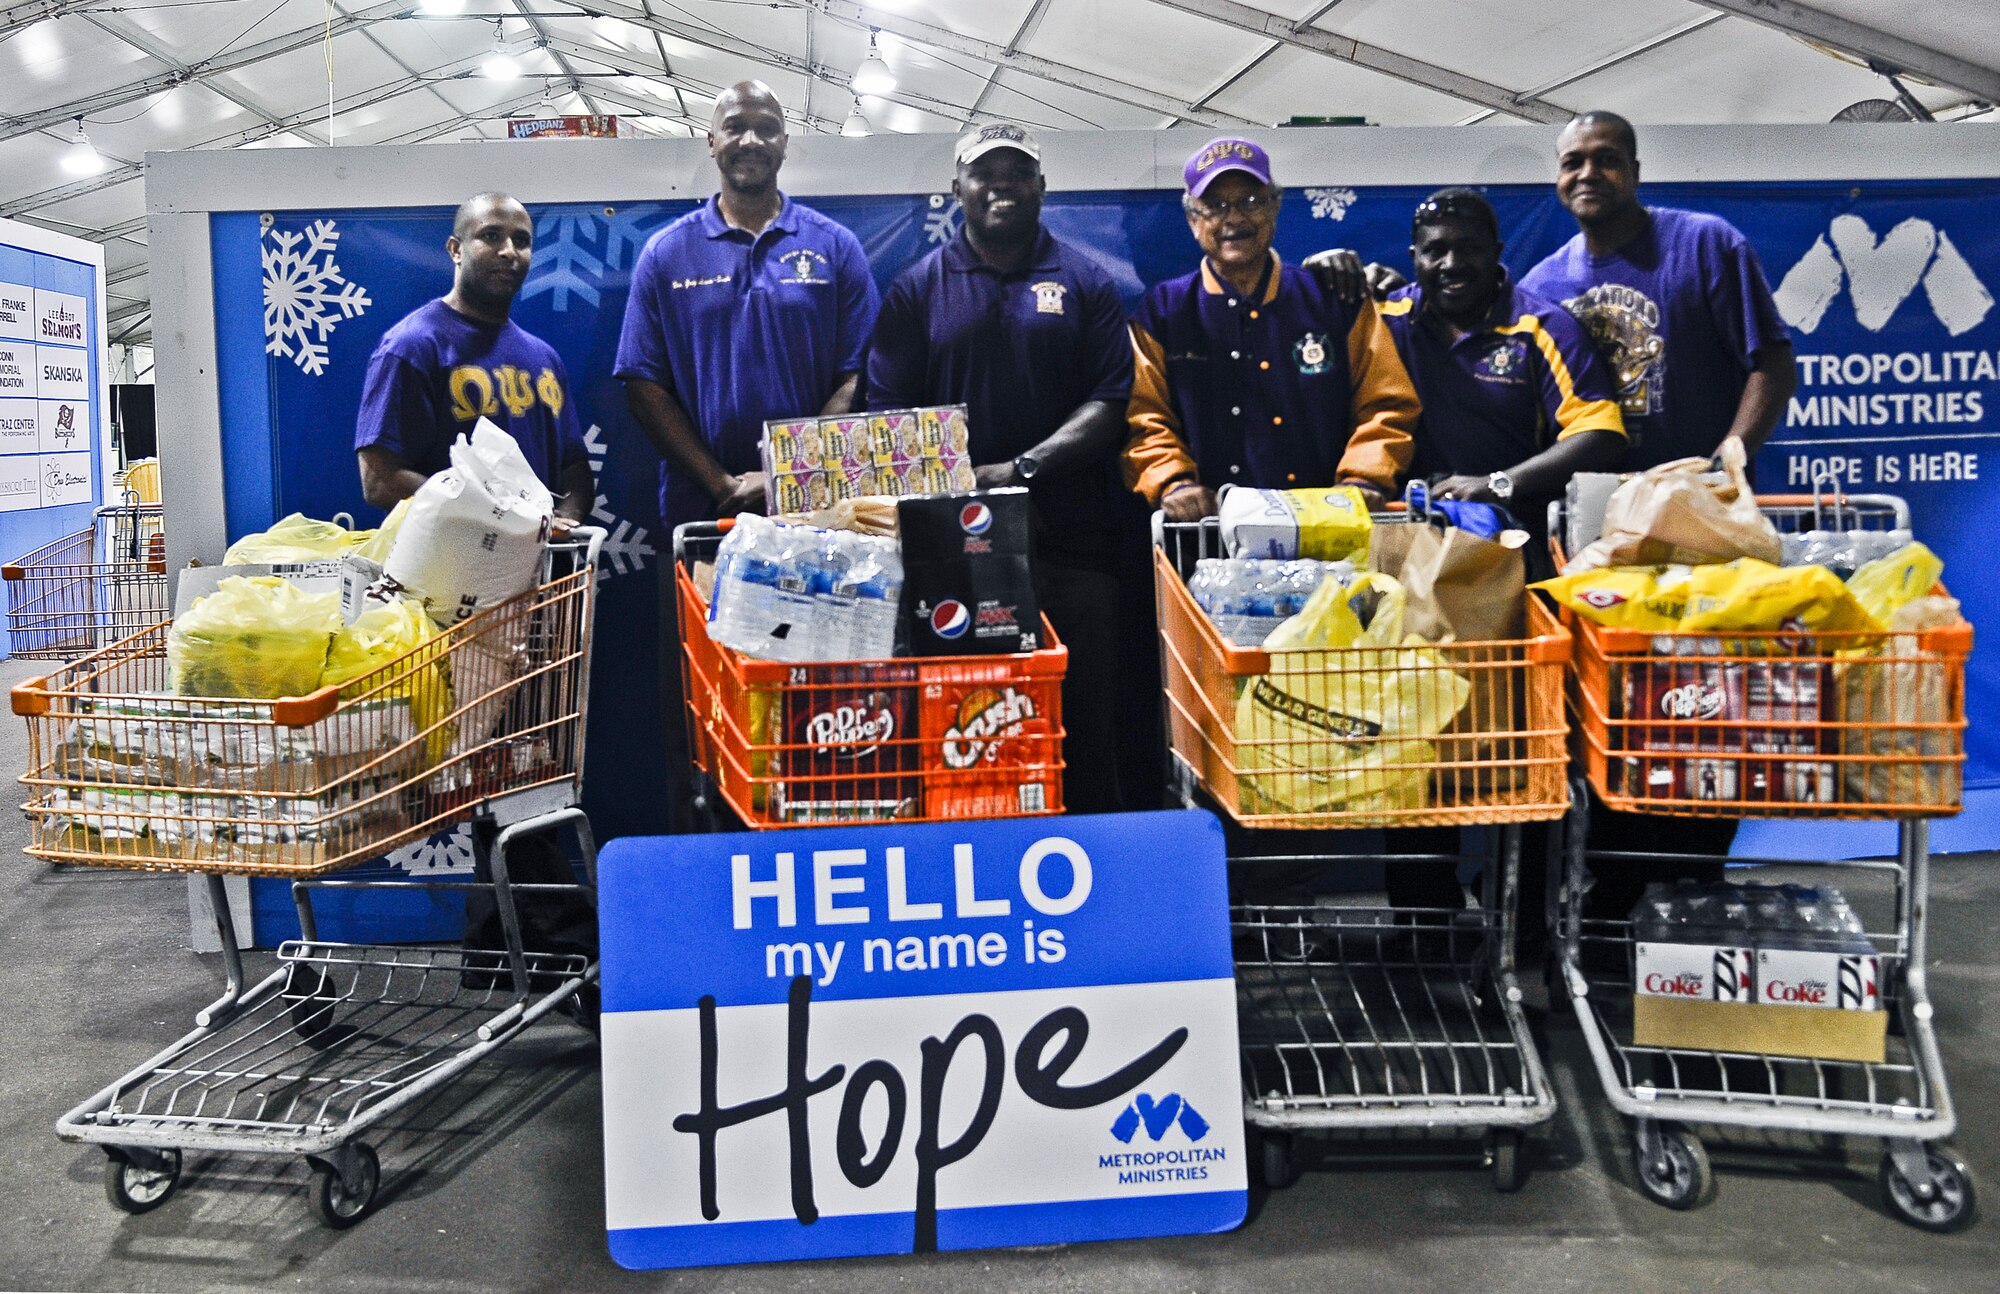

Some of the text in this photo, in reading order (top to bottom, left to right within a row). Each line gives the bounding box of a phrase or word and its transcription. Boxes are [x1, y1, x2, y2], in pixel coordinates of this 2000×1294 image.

[513, 119, 566, 138] HEDBANZ
[42, 317, 82, 340] SELMON'S
[44, 365, 83, 382] SKANSKA
[1796, 351, 2000, 386] TROPOLITA
[1786, 391, 1984, 427] MINISTRIES
[14, 418, 35, 430] CENTER
[1788, 452, 1979, 486] HOPE IS HERE
[789, 667, 807, 683] 24
[1683, 683, 1707, 700] Dr
[837, 706, 868, 727] Dr
[942, 687, 1035, 768] Crush
[810, 711, 885, 753] Pepper
[730, 836, 1094, 930] HELLO
[765, 919, 1067, 986] my name is
[1645, 972, 1703, 996] Coke
[1766, 979, 1826, 1004] Coke
[672, 974, 1189, 1254] Hope
[1098, 1147, 1226, 1168] METROPOLITAN
[1118, 1166, 1209, 1184] MINISTRIES
